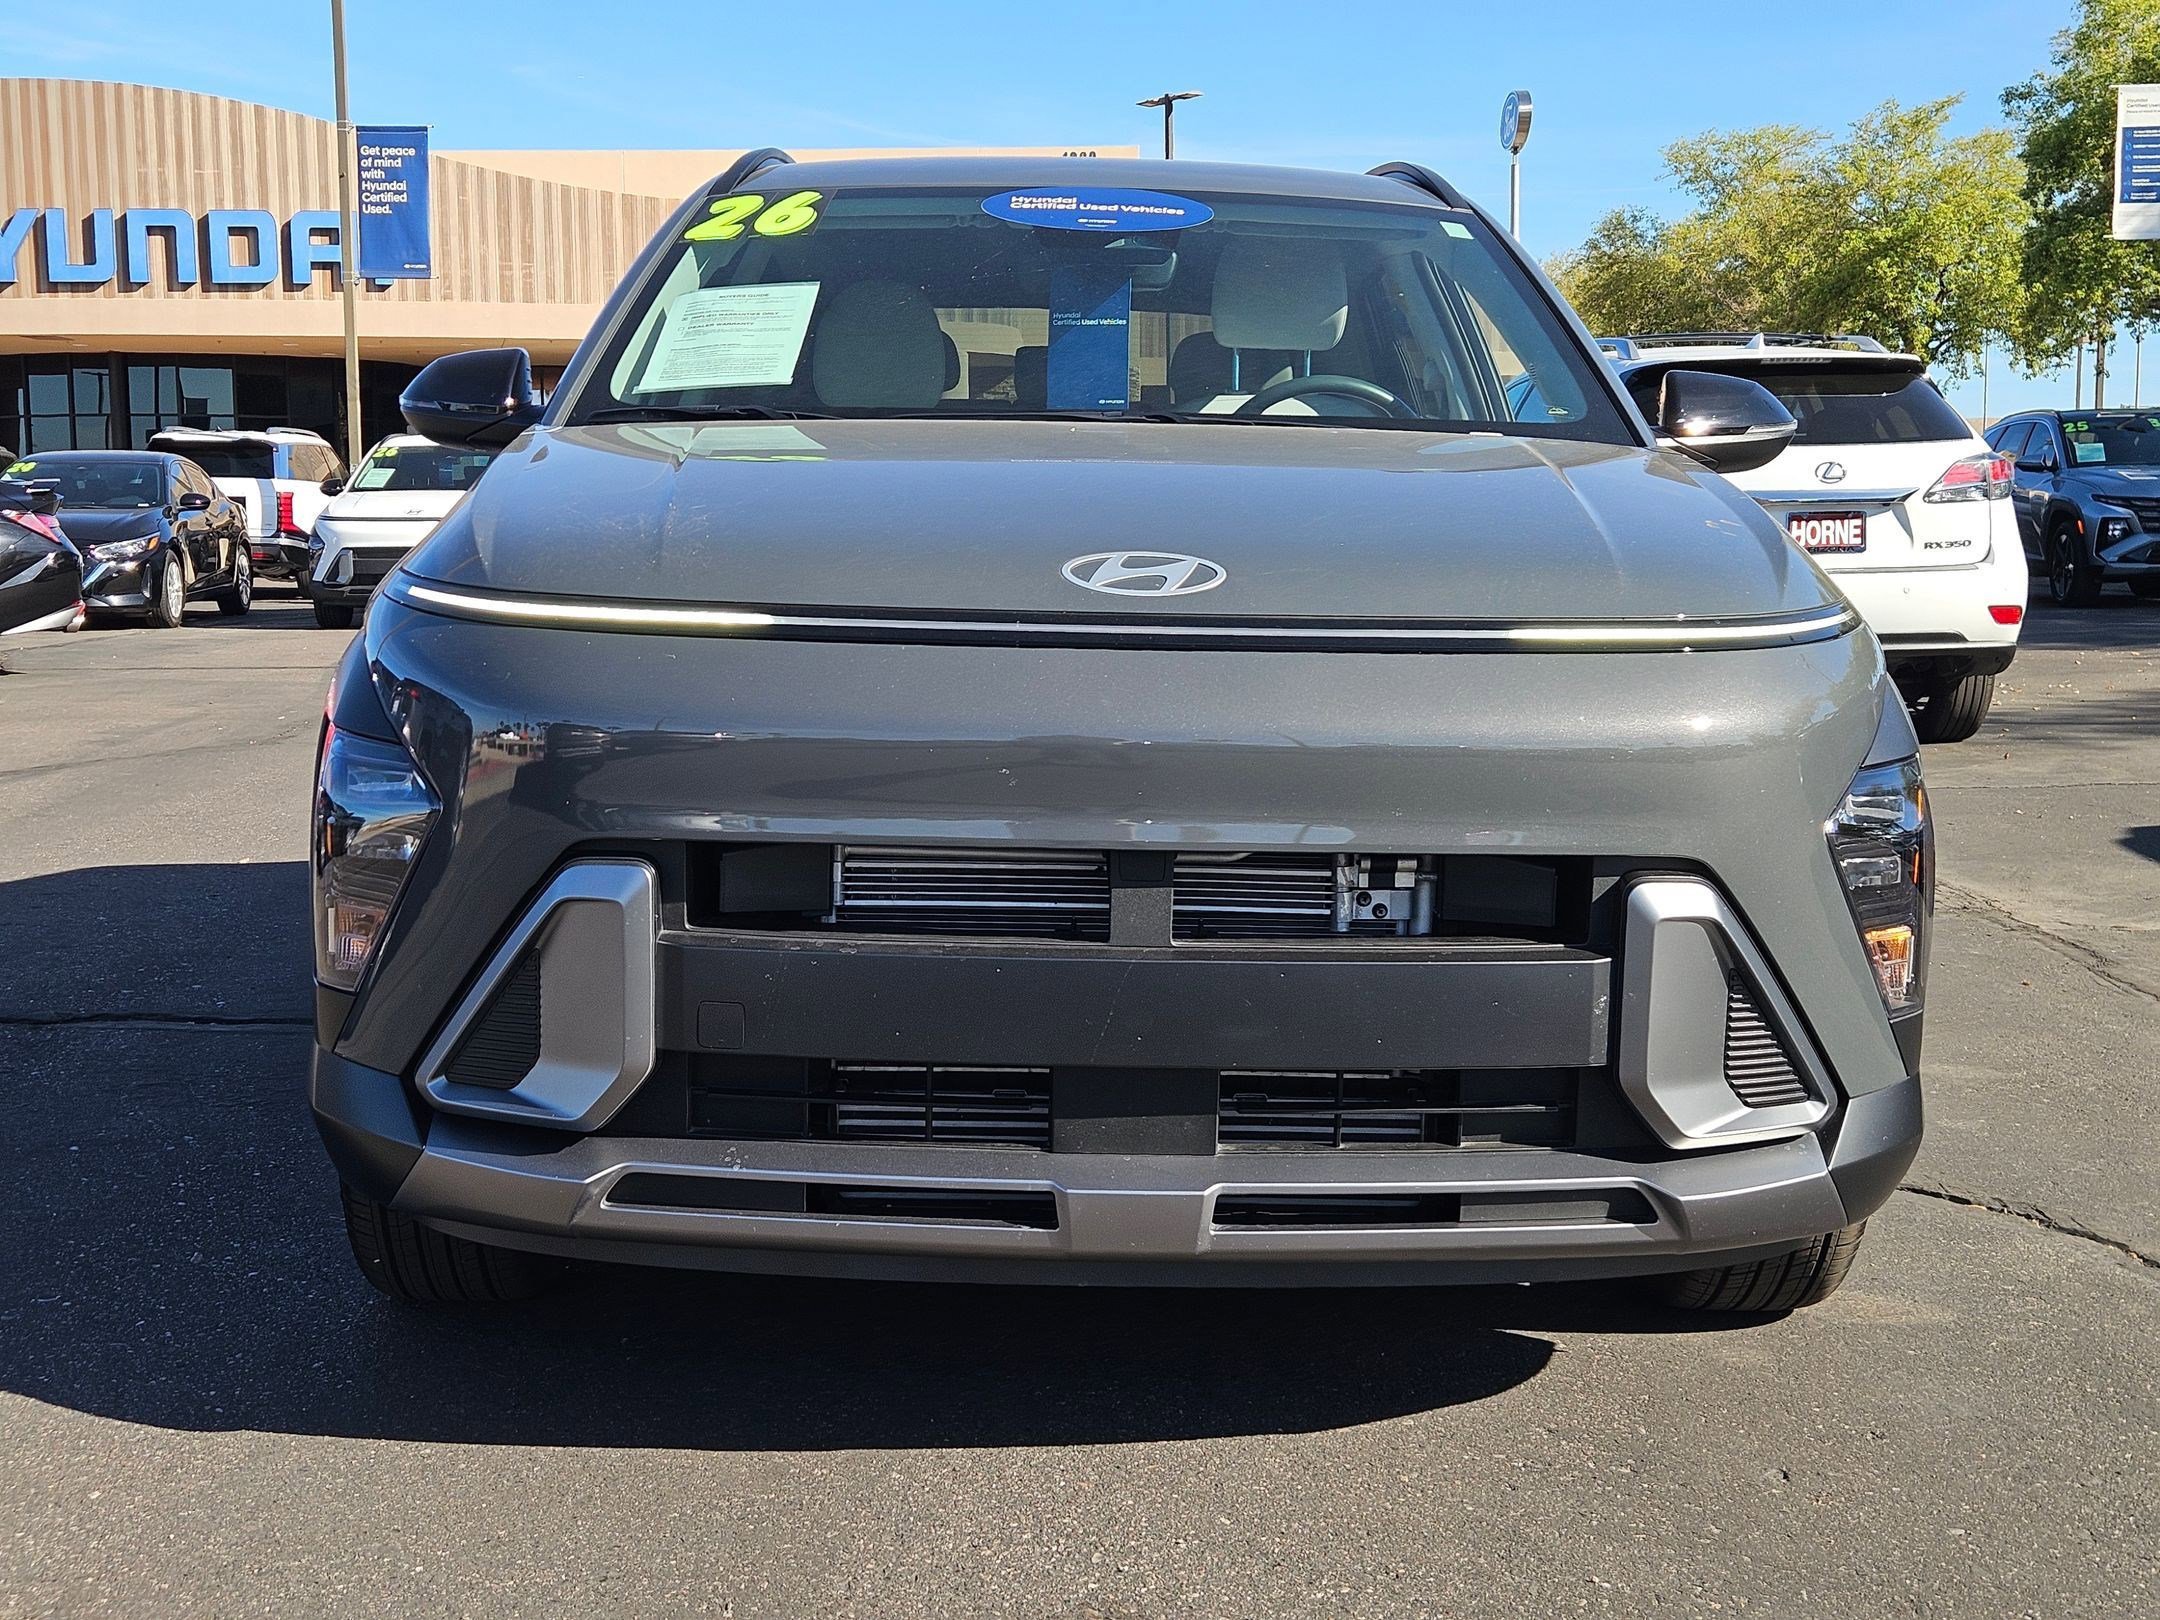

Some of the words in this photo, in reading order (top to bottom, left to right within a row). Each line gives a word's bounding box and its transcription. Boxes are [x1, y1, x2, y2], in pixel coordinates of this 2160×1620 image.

[360, 145, 381, 156] Get
[381, 147, 416, 157] peace
[360, 157, 373, 167] of
[374, 157, 402, 167] mind
[361, 169, 385, 179] with
[361, 180, 407, 192] Hyundai
[361, 192, 408, 203] Certified
[1010, 195, 1078, 205] Hyundai
[362, 204, 393, 214] Used.
[1009, 201, 1078, 210] Certified
[1079, 203, 1119, 211] Used
[1120, 205, 1186, 216] Vehicles
[683, 190, 823, 241] 26
[0, 207, 393, 285] YUNDA
[1052, 311, 1081, 319] Hyundai
[1052, 318, 1081, 326] Certified
[2063, 421, 2089, 432] 25
[372, 446, 399, 458] 26
[1791, 519, 1862, 546] HORNE
